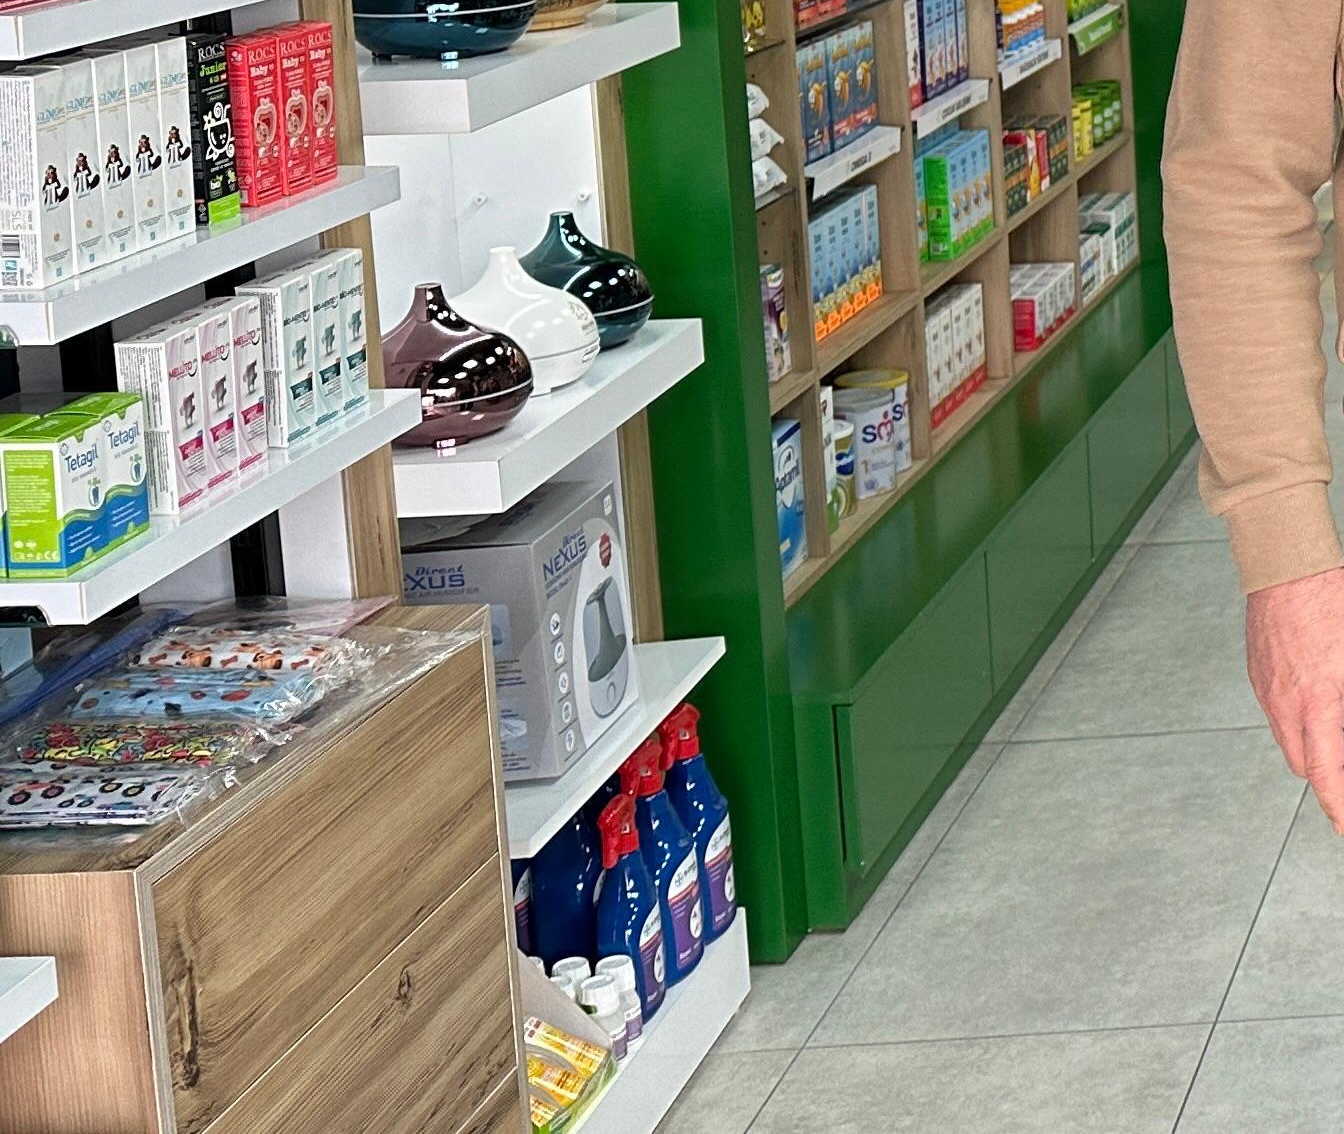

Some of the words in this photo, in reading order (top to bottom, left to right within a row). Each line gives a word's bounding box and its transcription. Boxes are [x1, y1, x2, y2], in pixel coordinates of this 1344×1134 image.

[107, 422, 141, 451] Tetagil
[64, 445, 99, 474] Tetagil
[543, 535, 588, 583] NEXUS
[404, 573, 466, 592] XUS
